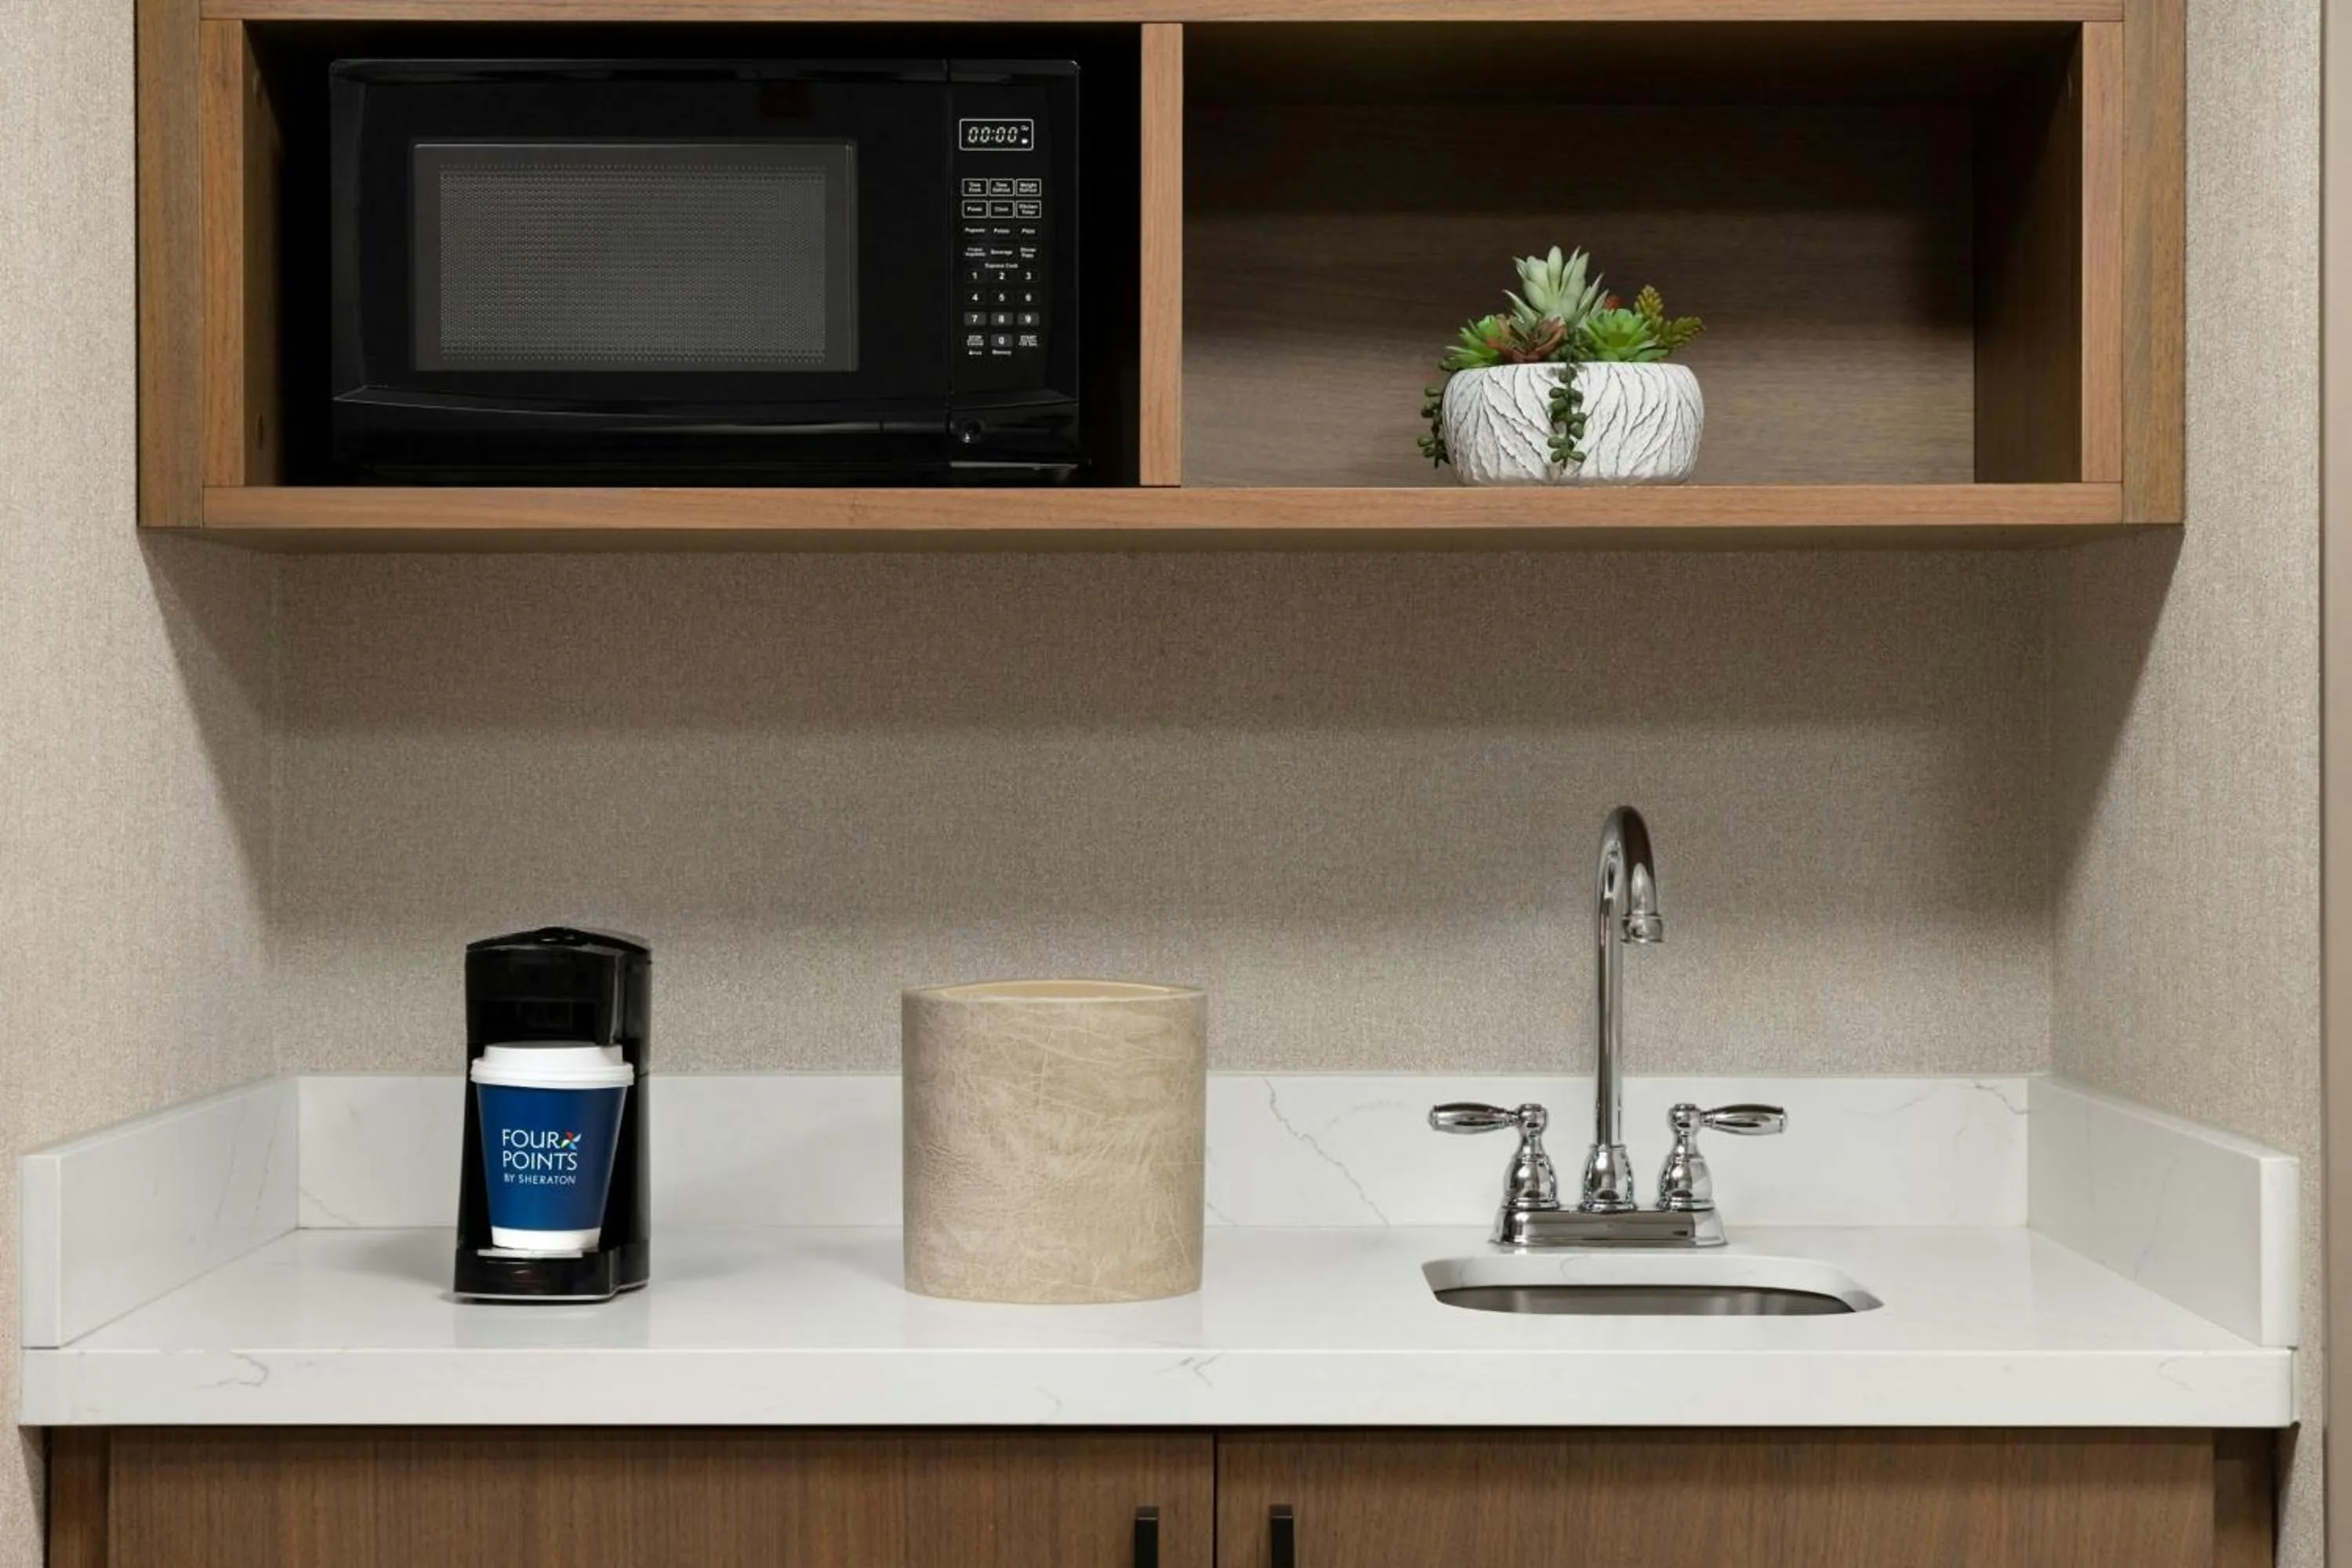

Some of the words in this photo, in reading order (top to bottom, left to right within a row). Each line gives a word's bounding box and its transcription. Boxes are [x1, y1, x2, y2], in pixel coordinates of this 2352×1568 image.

[968, 125, 1018, 143] 00:00
[972, 314, 978, 323] 7
[998, 336, 1004, 345] 0
[502, 1128, 561, 1149] FOUR
[503, 1150, 578, 1171] POINTS
[503, 1173, 515, 1183] BY
[518, 1174, 576, 1185] SHERATON
